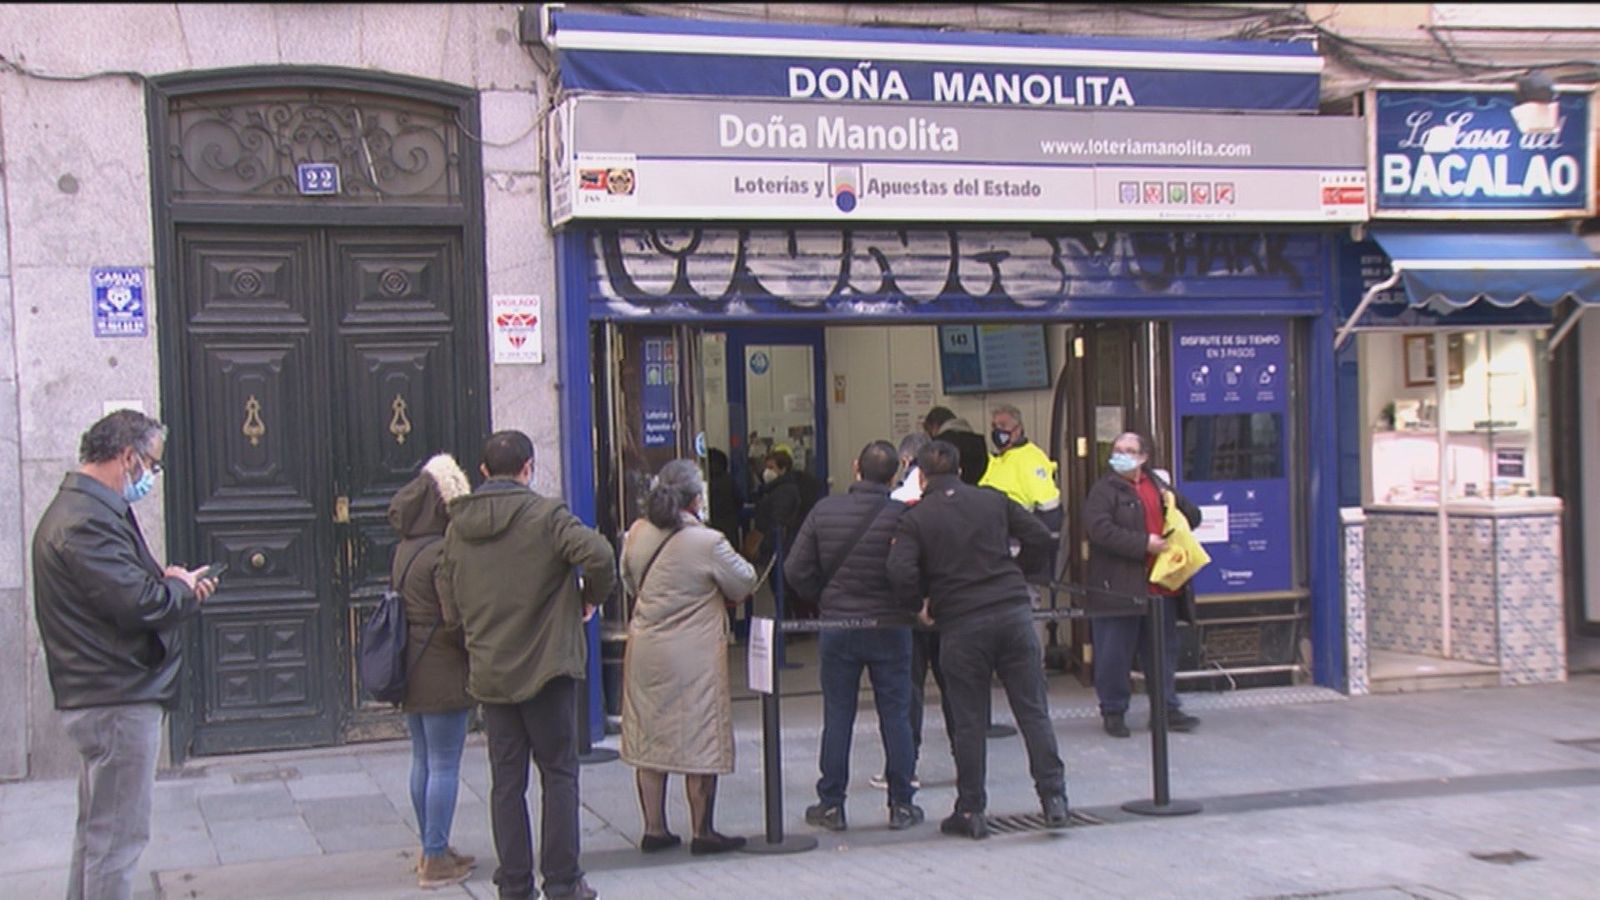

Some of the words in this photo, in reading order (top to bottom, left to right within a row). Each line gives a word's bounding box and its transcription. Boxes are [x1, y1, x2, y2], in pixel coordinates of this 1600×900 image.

[788, 62, 909, 100] DOÑA
[932, 71, 1135, 107] MANOLITA
[719, 114, 808, 149] Doña
[817, 116, 960, 152] Manolita
[1040, 138, 1251, 158] www.loteriamanolita.com
[306, 169, 332, 188] 22
[1383, 153, 1579, 197] BACALAO
[734, 174, 809, 194] Loterías
[814, 180, 825, 199] y
[867, 176, 948, 198] Apuestas
[953, 177, 979, 196] del
[984, 179, 1041, 198] Estado
[1181, 335, 1219, 346] DISFRUTE
[1222, 335, 1233, 345] DE
[1235, 334, 1247, 345] SU
[1249, 334, 1280, 345] TIEMPO
[1206, 348, 1218, 358] EN
[1228, 347, 1255, 358] PASOS
